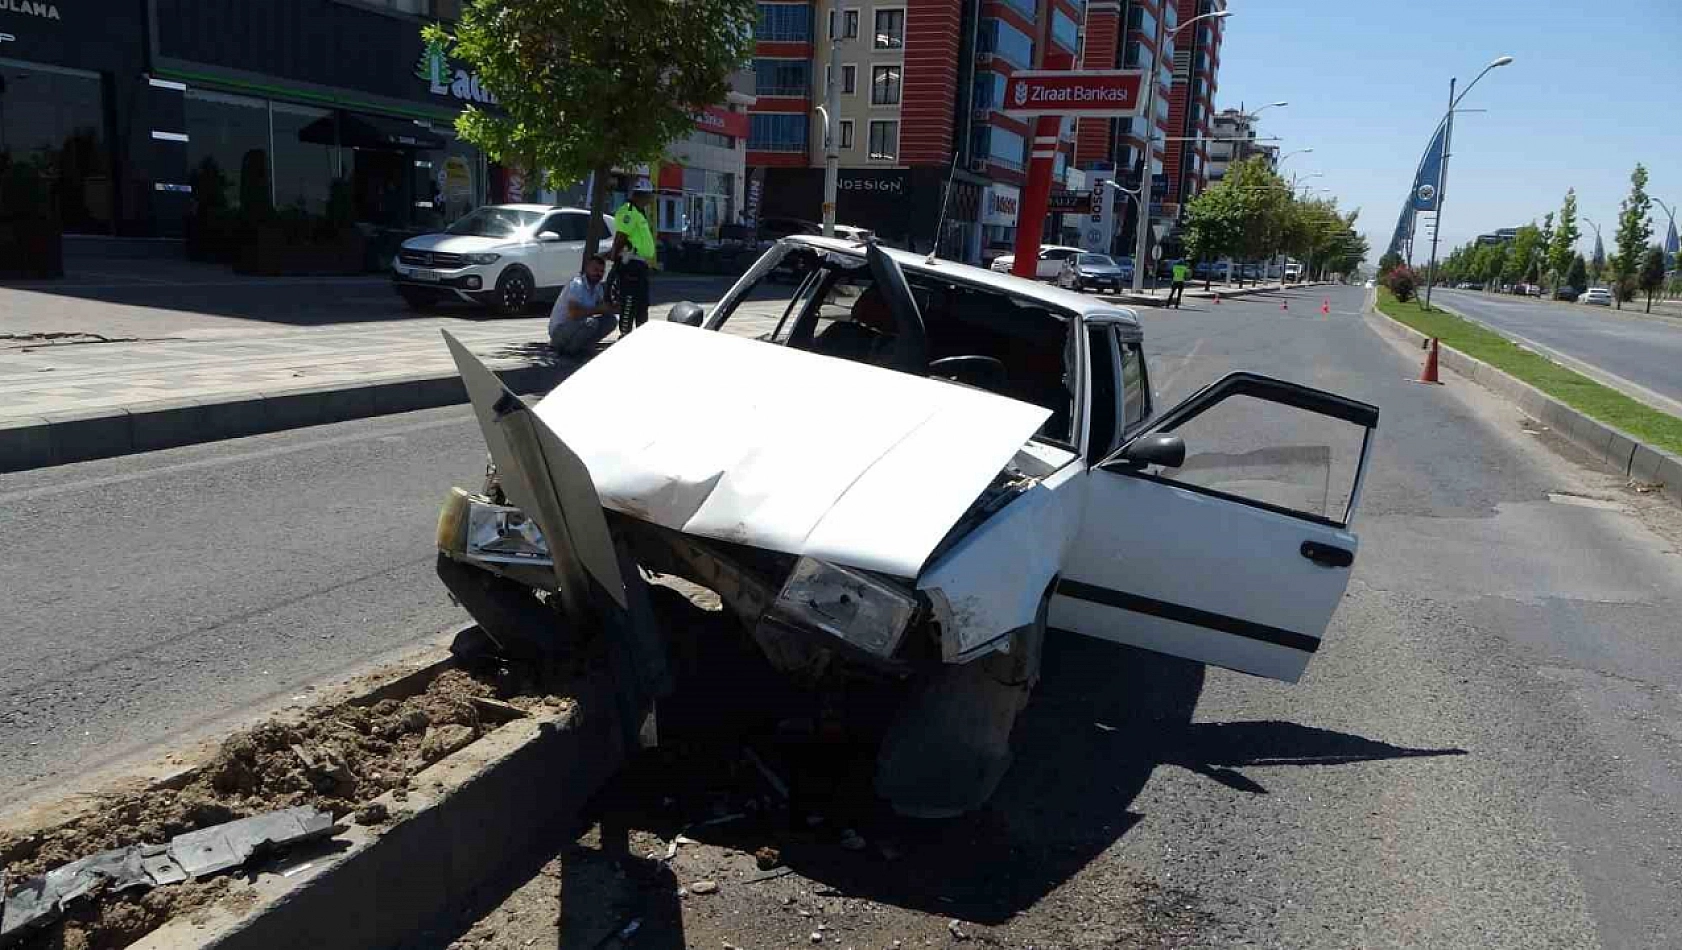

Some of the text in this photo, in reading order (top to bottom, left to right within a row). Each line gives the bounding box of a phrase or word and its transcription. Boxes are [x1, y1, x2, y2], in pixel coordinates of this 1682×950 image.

[1031, 85, 1128, 101] Ziraat Bankası
[1092, 177, 1105, 223] BOSCH
